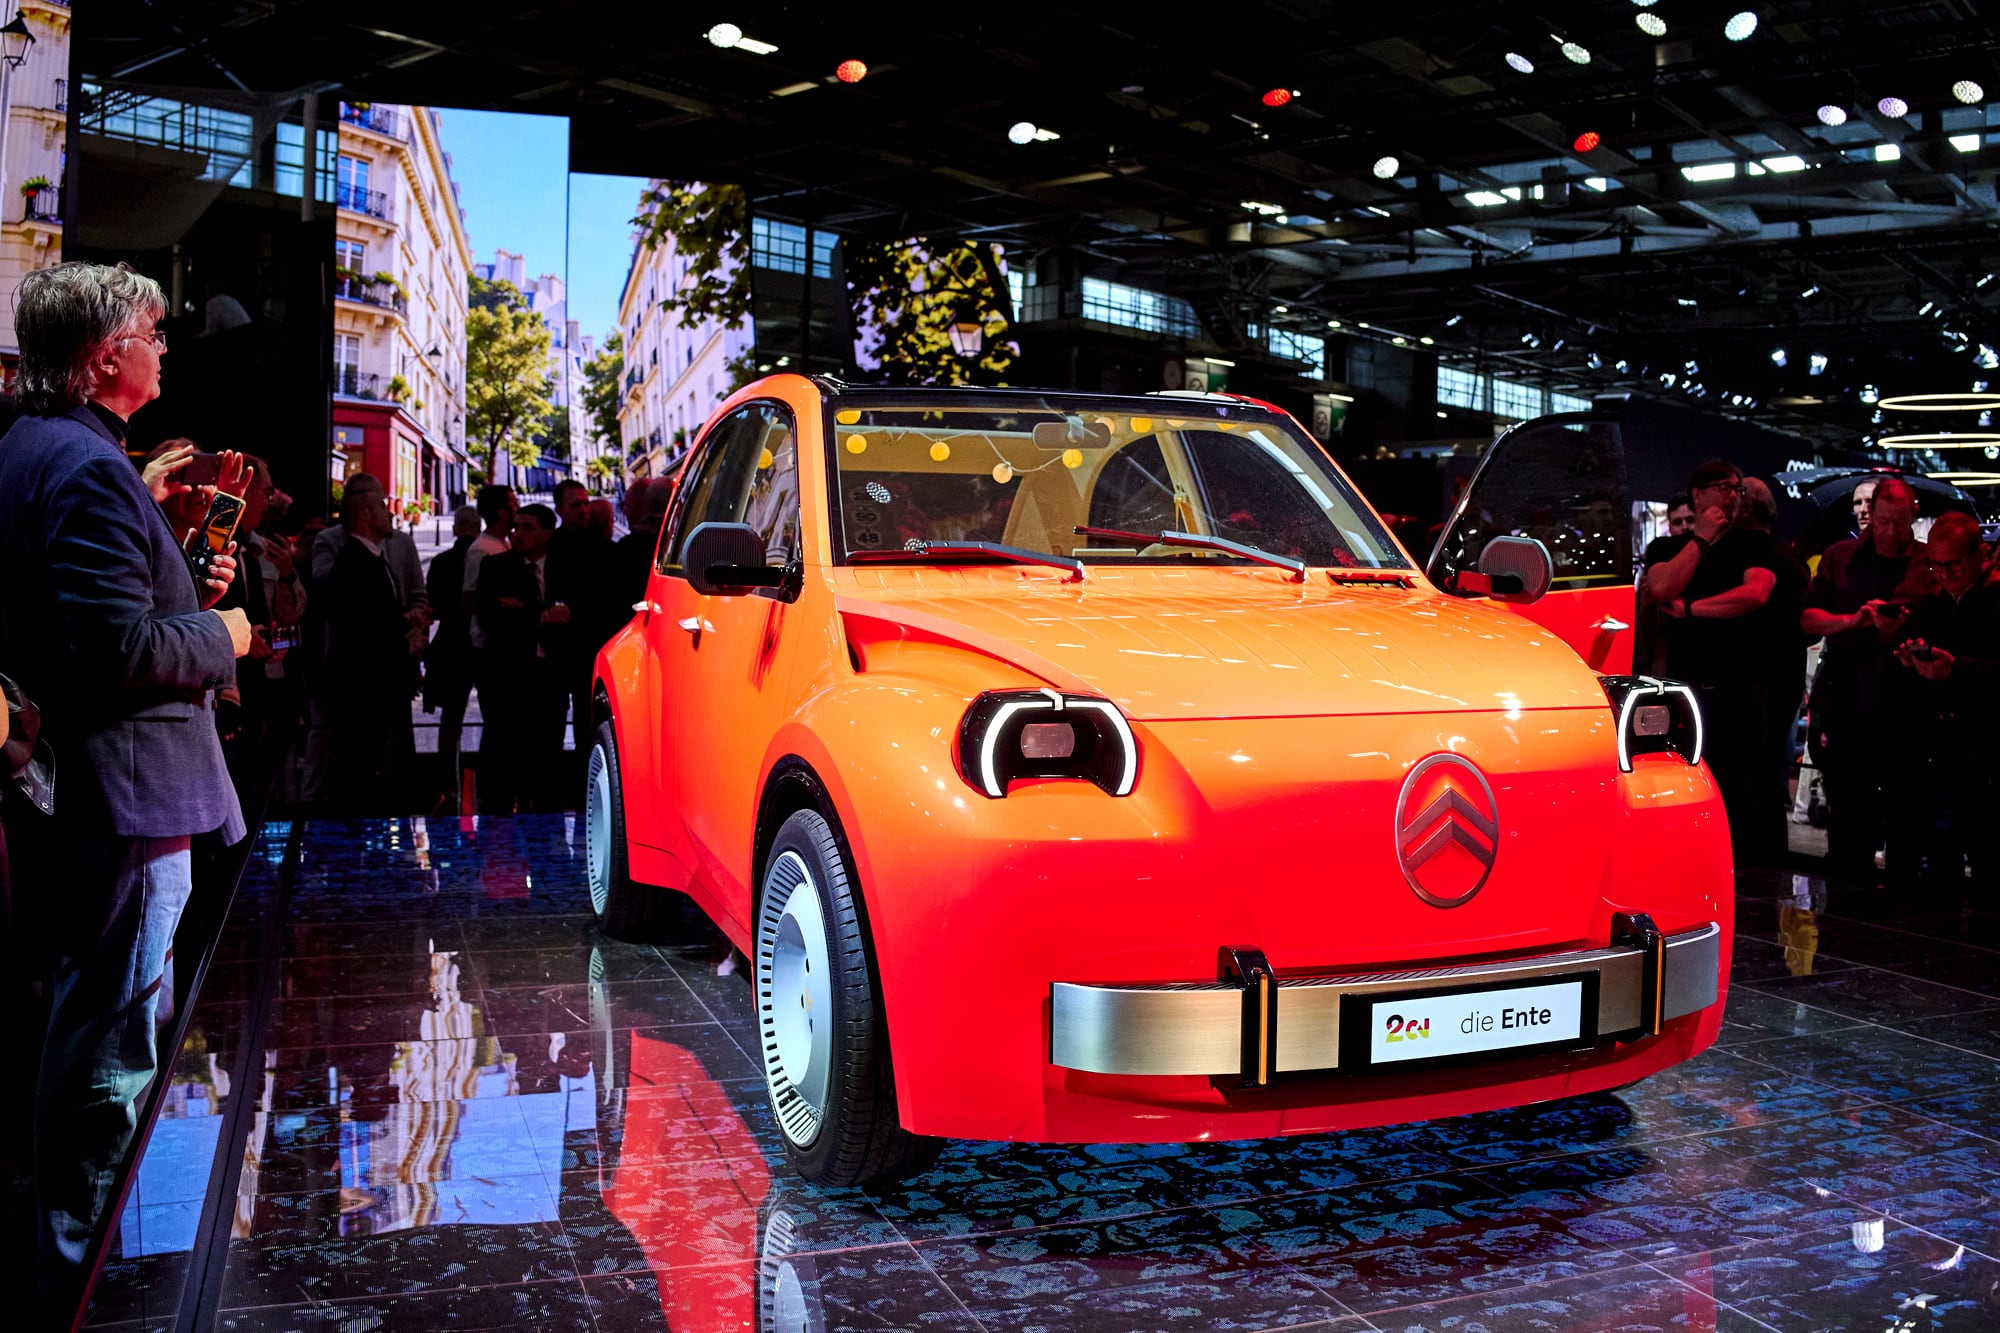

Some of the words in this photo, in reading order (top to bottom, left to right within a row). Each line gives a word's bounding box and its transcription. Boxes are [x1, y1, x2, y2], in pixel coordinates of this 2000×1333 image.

[858, 532, 880, 545] 48
[1461, 1011, 1494, 1034] die
[1501, 1006, 1552, 1030] Ente
